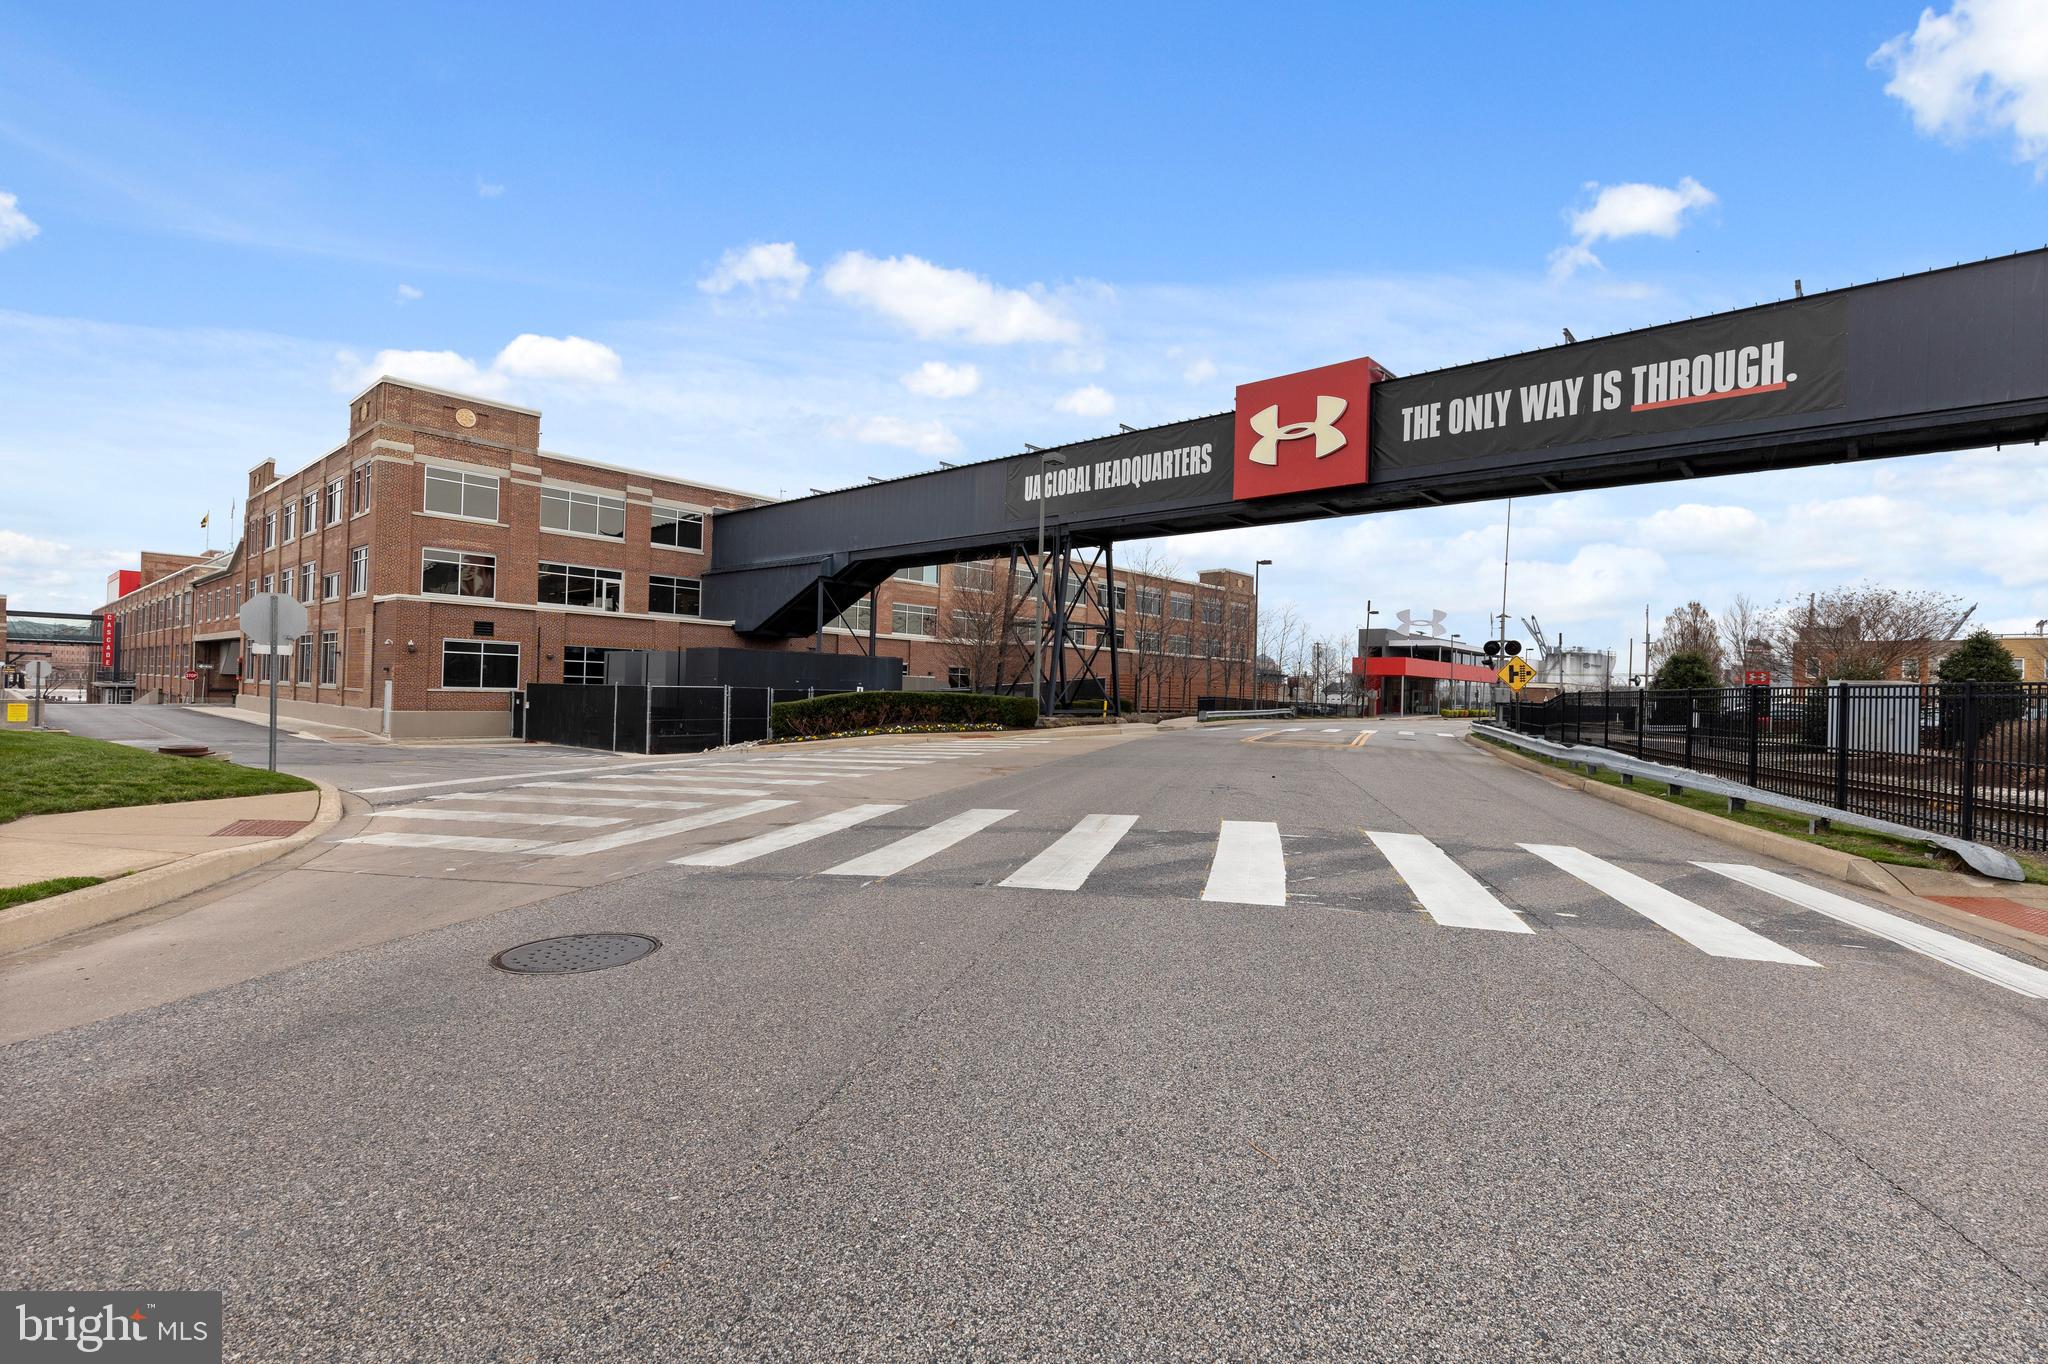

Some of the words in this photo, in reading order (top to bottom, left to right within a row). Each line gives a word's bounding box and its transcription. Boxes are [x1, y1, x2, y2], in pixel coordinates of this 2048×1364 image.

[1401, 402, 1441, 442] THE
[1448, 389, 1512, 434] ONLY
[1520, 376, 1584, 423] WAY
[1592, 370, 1621, 412] IS
[1631, 341, 1797, 407] THROUGH.
[1024, 475, 1041, 501] UA
[1044, 465, 1091, 498] GLOBAL
[1094, 443, 1212, 489] HEADQUARTERS
